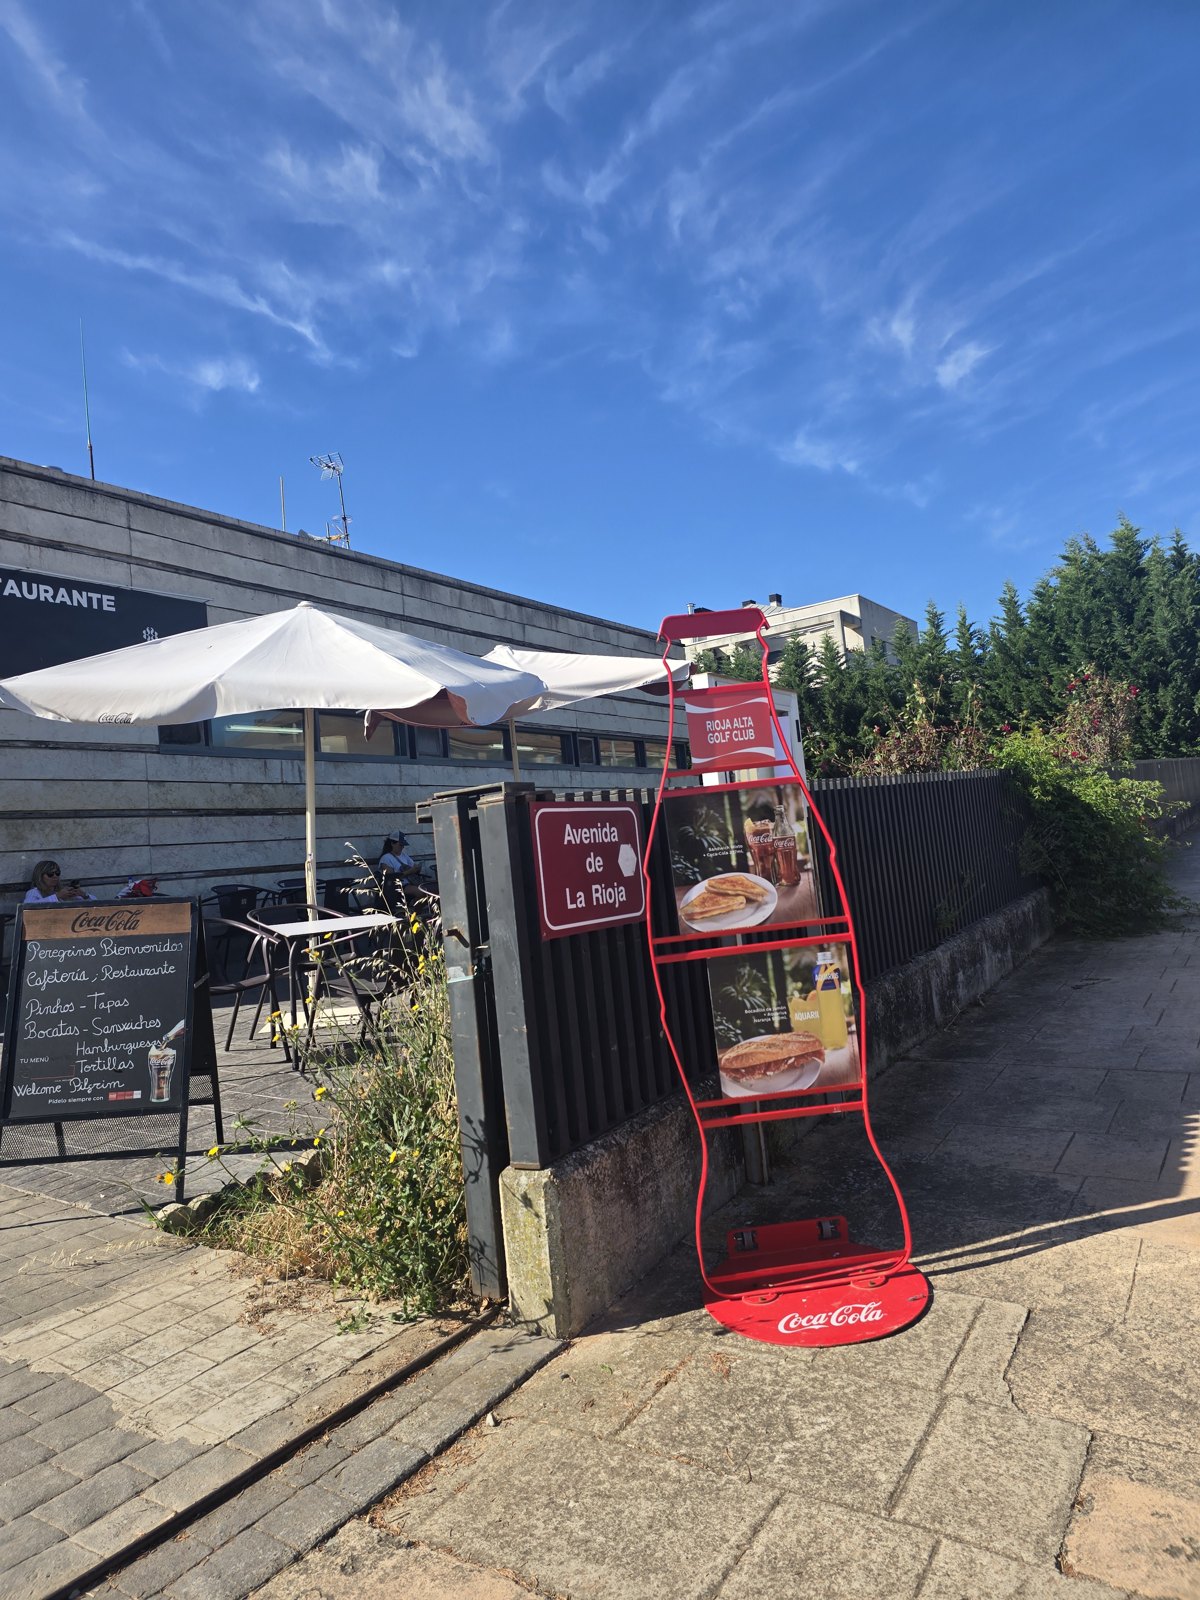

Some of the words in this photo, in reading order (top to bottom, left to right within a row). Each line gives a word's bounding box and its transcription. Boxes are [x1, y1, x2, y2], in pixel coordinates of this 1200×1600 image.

[0, 578, 116, 612] AURANTE
[706, 718, 732, 731] RIOJA
[733, 716, 754, 729] ALTA
[708, 731, 730, 744] GOLF
[732, 729, 755, 741] CLUB
[563, 822, 619, 845] Avenida
[585, 851, 604, 873] de
[565, 887, 586, 910] La
[591, 882, 627, 908] Rioja
[27, 941, 97, 963] Peregrinos
[100, 937, 183, 957] Bienvenidos
[101, 960, 176, 982] Restaurante
[25, 998, 75, 1020] Pinchos
[86, 991, 130, 1014] Tapas
[24, 1019, 80, 1040] Bocatas
[75, 1056, 134, 1073] Tortillas
[12, 1082, 62, 1097] Welcome
[69, 1076, 125, 1094] Pilgrim
[777, 1301, 883, 1334] Coca-Cola
